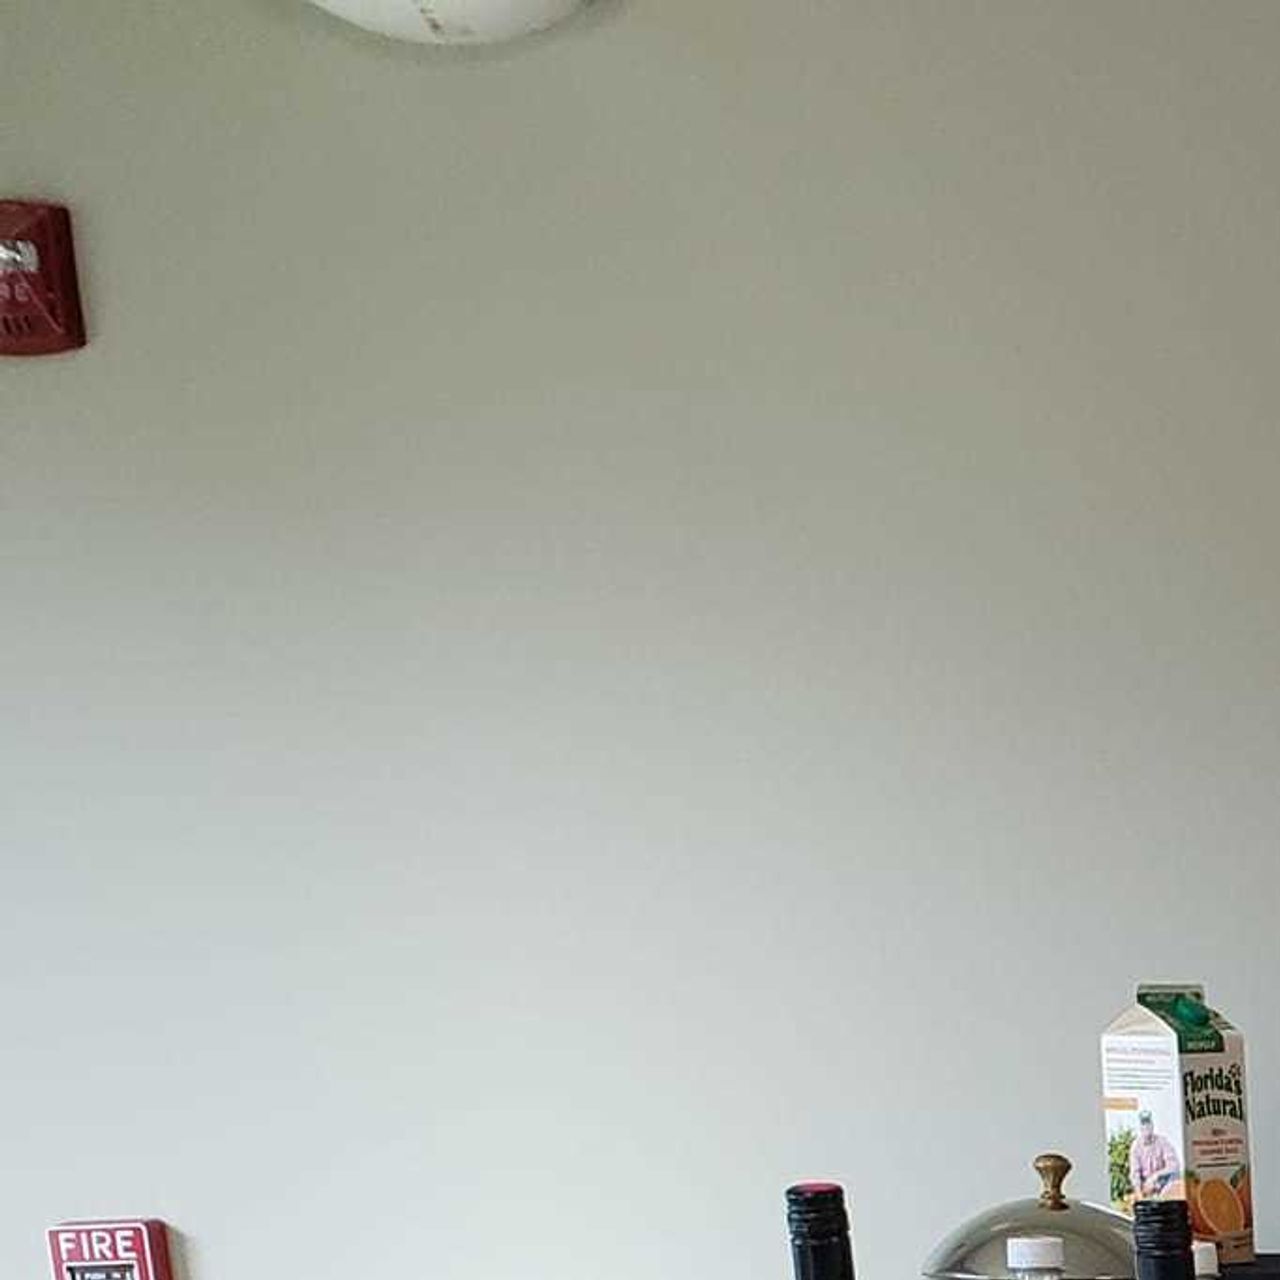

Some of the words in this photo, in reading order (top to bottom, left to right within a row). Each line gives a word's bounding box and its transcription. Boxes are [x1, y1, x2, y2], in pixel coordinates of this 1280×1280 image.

[1183, 1066, 1243, 1096] Florida's
[1184, 1095, 1243, 1124] Natural
[58, 1230, 137, 1261] FIRE
